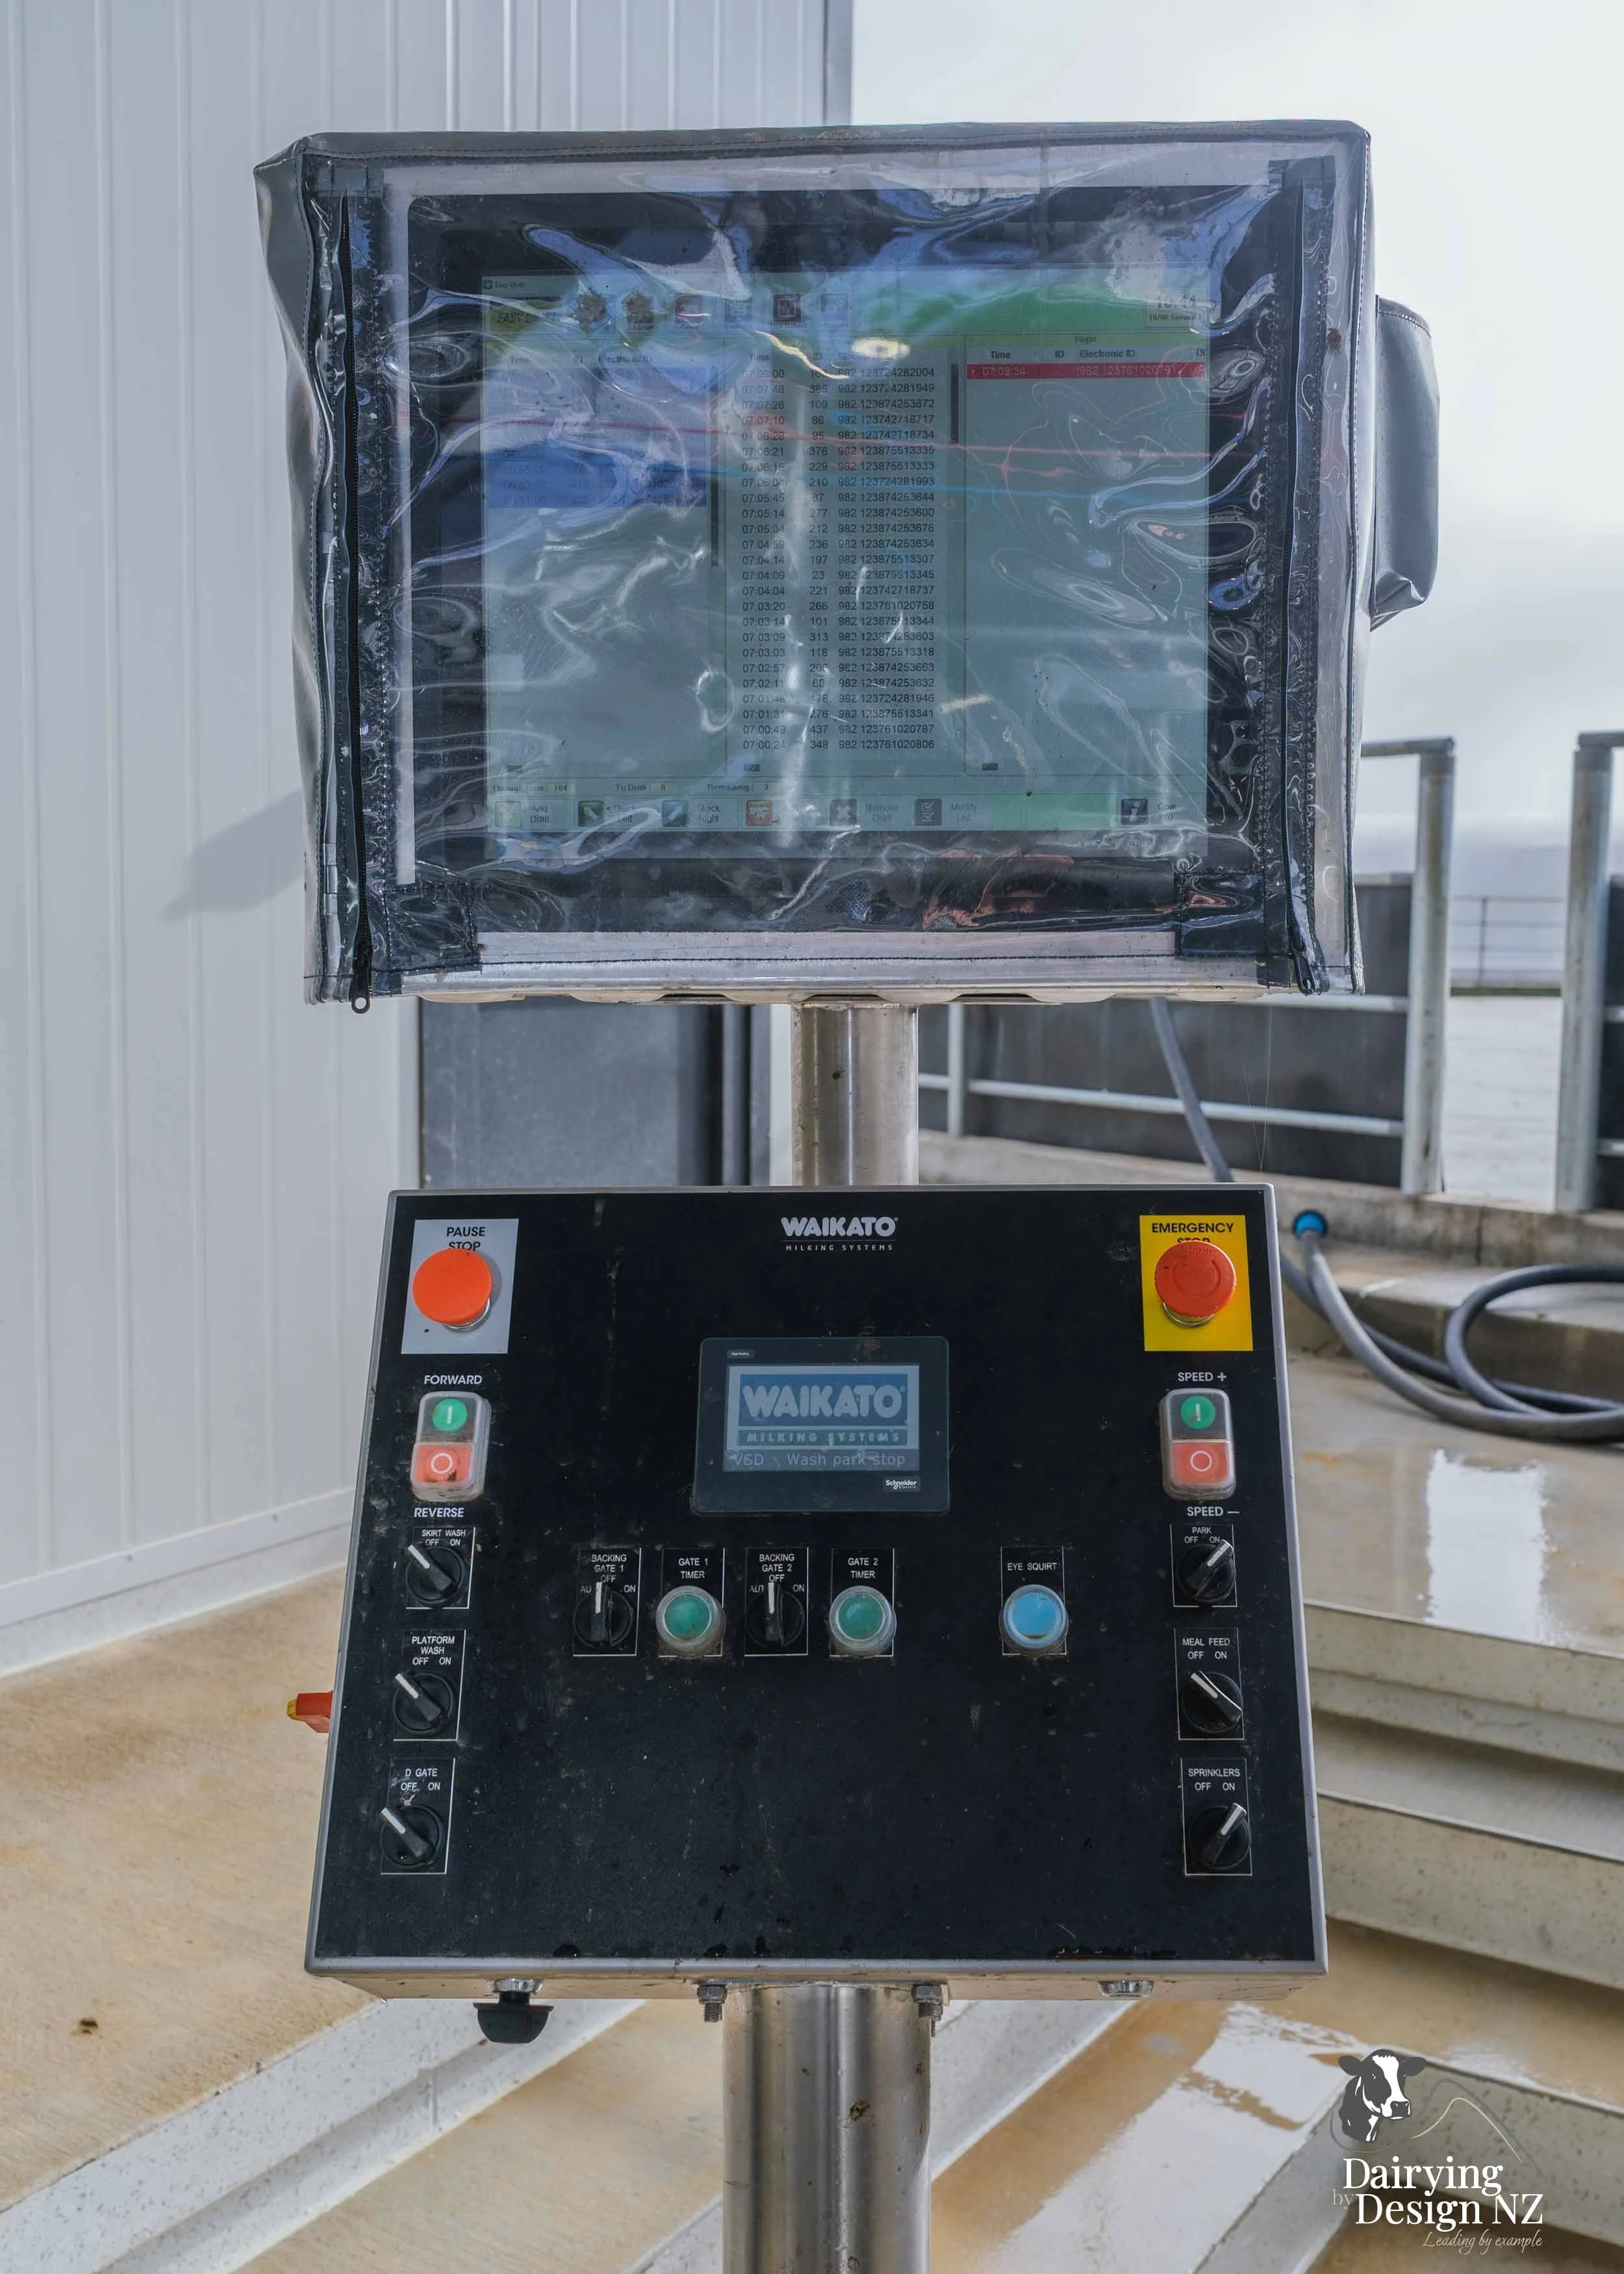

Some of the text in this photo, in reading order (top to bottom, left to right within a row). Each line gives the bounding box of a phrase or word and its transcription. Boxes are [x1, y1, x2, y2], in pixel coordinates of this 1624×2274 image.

[990, 350, 1011, 359] Time
[1055, 350, 1065, 359] ID
[1080, 349, 1136, 359] Electronic ID
[838, 493, 857, 502] 982
[838, 509, 857, 517] 982
[809, 525, 828, 533] 212
[838, 524, 857, 533] 982
[742, 572, 785, 580] 07:04:09
[838, 570, 857, 579] 982
[742, 586, 935, 595] 07:04:04 221 982 123742718737
[742, 602, 785, 611] 07:03:20
[809, 602, 828, 611] 266
[838, 602, 857, 610] 982
[809, 618, 828, 626] 101
[838, 617, 857, 626] 982
[742, 633, 785, 641] 07:03:09
[742, 647, 935, 657] 07:03:03 982 123875513318
[742, 663, 785, 672] 07:02:57
[838, 709, 857, 718] 982
[860, 724, 935, 734] 123761020787
[838, 740, 857, 748] 982
[860, 740, 935, 748] 123761020806
[865, 803, 899, 812] Remove
[781, 1216, 896, 1237] WAIKATO
[1152, 1222, 1234, 1233] EMERGENCY
[446, 1227, 486, 1237] PAUSE
[448, 1241, 481, 1251] STOP
[424, 1375, 483, 1385] FORWARD
[1177, 1372, 1213, 1382] SPEED
[742, 1385, 903, 1418] WAIKATO
[746, 1432, 900, 1442] MILKING SYSTEMS
[734, 1453, 906, 1468] VSD Wash park stop
[885, 1479, 917, 1490] Schneider
[414, 1507, 465, 1518] REVERSE
[1187, 1506, 1223, 1516] SPEED
[592, 1553, 628, 1563] BACKING
[678, 1557, 709, 1566] GATE 1
[759, 1553, 795, 1562] BACKING
[847, 1557, 878, 1566] GATE 2
[594, 1564, 624, 1573] GATE 1
[761, 1563, 793, 1572] GATE 2
[1007, 1562, 1058, 1571] EYE SQUIRT
[600, 1574, 617, 1583] OFF
[680, 1570, 705, 1579] TIMER
[768, 1574, 785, 1582] OFF
[850, 1570, 876, 1579] TIMER
[623, 1585, 637, 1593] ON
[792, 1584, 806, 1592] ON
[412, 1636, 455, 1644] PLATFORM
[1182, 1637, 1230, 1646] MEAL FEED
[420, 1646, 445, 1655] WASH
[1187, 1651, 1227, 1659] OFF ON
[412, 1657, 452, 1665] OFF ON
[405, 1768, 438, 1777] D GATE
[1187, 1768, 1241, 1778] SPRINKLERS
[400, 1782, 441, 1791] OFF ON
[1195, 1782, 1236, 1791] OFF ON
